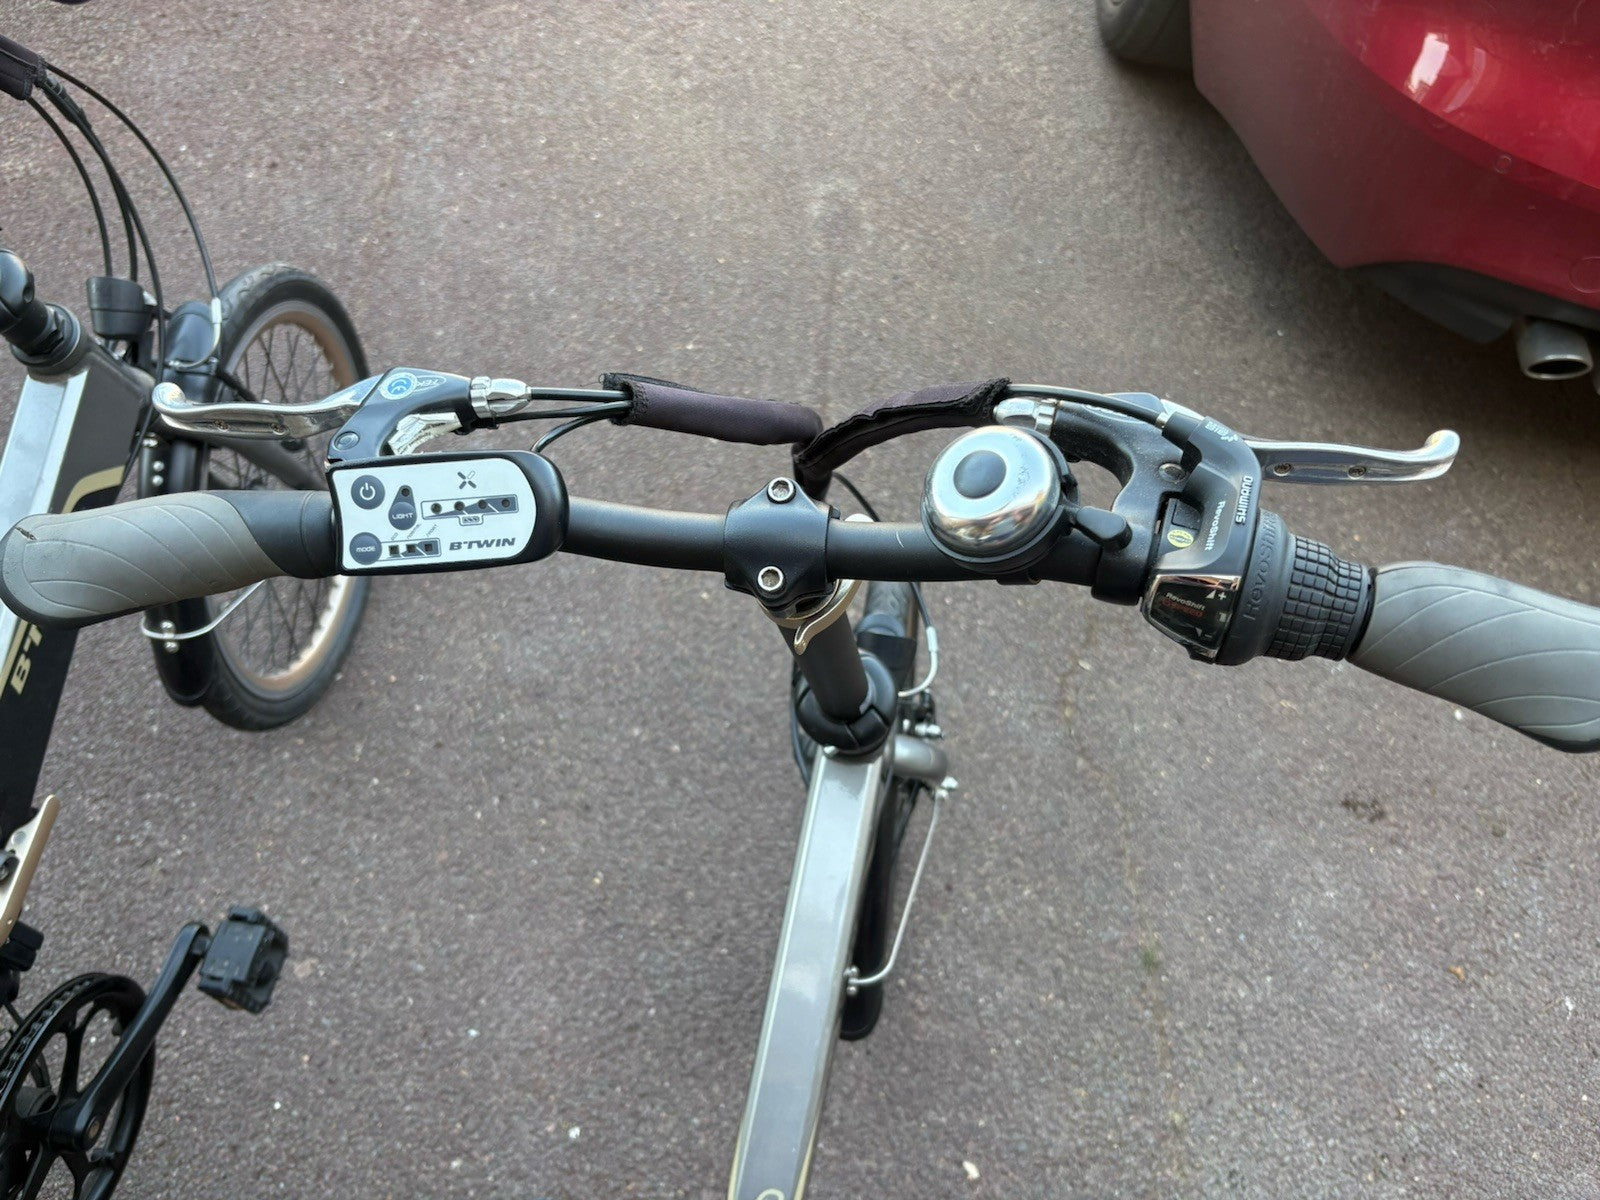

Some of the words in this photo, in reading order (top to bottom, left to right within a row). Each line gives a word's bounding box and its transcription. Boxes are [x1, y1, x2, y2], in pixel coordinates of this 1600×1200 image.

[392, 512, 414, 520] LIGHT
[1235, 475, 1254, 525] SHIMANO
[1204, 500, 1226, 551] RevoShift
